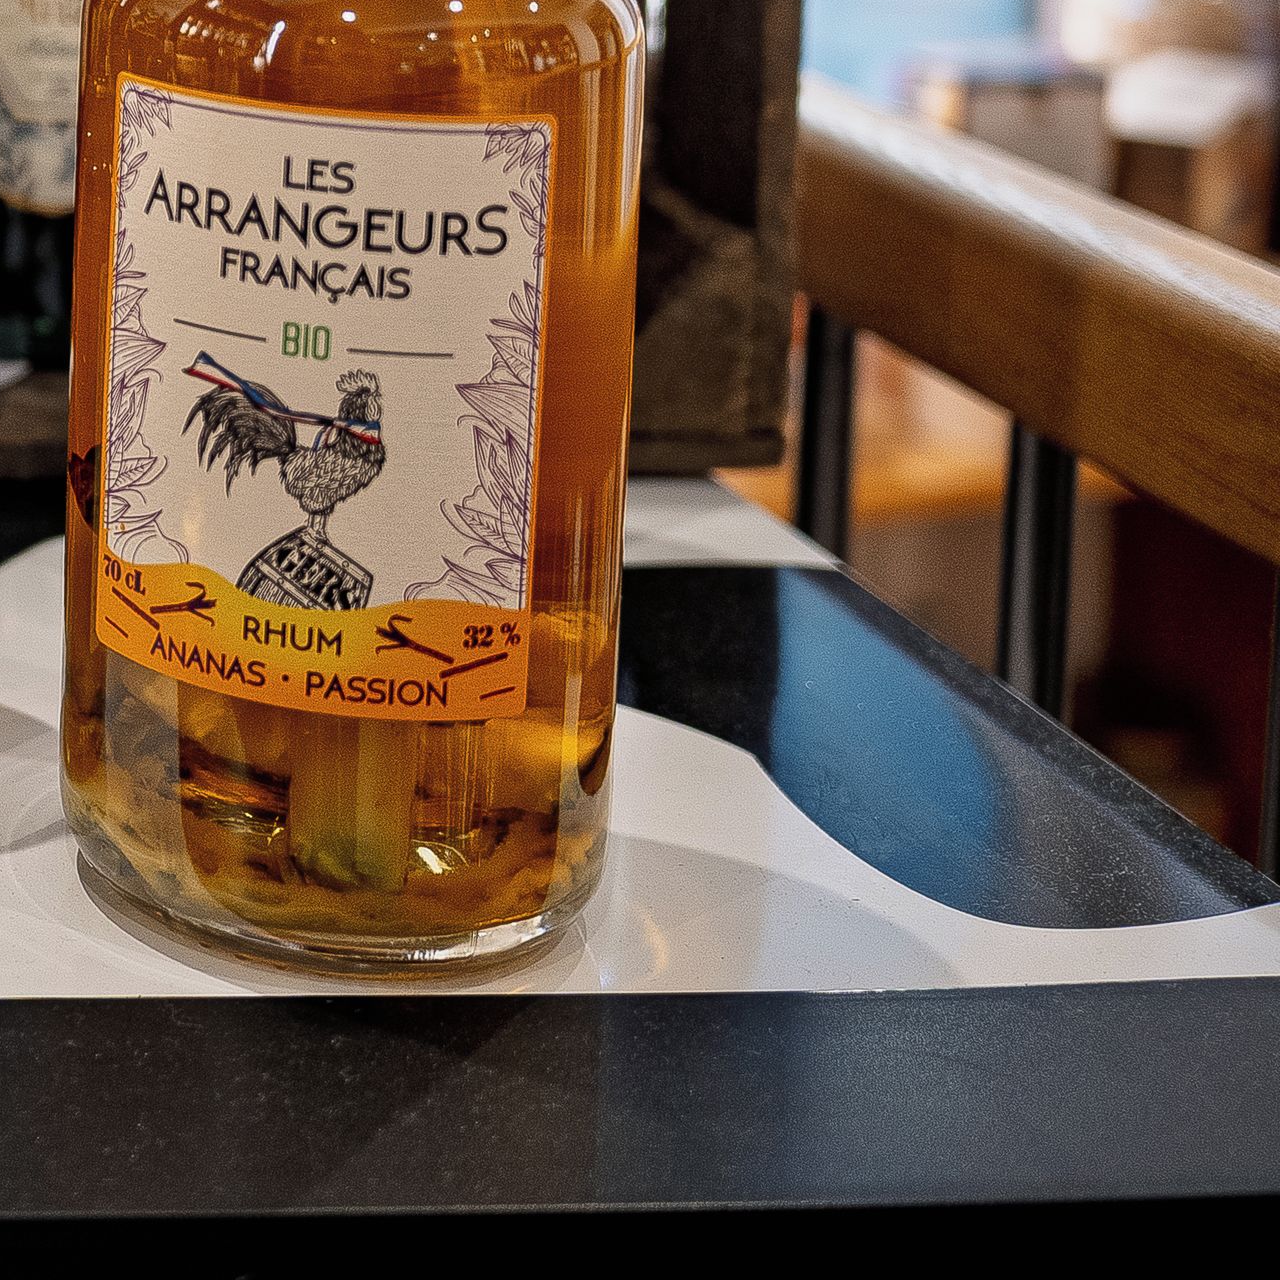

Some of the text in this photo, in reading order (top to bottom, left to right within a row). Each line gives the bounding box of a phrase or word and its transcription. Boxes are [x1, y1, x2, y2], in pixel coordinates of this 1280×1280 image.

[282, 155, 355, 194] LES
[144, 167, 509, 258] ARRANGEURS
[220, 249, 412, 304] FRANÇAIS
[281, 321, 332, 362] BIO
[243, 615, 342, 657] RHUM
[462, 622, 521, 649] 32 %
[150, 631, 448, 708] ANANAS PASSION
